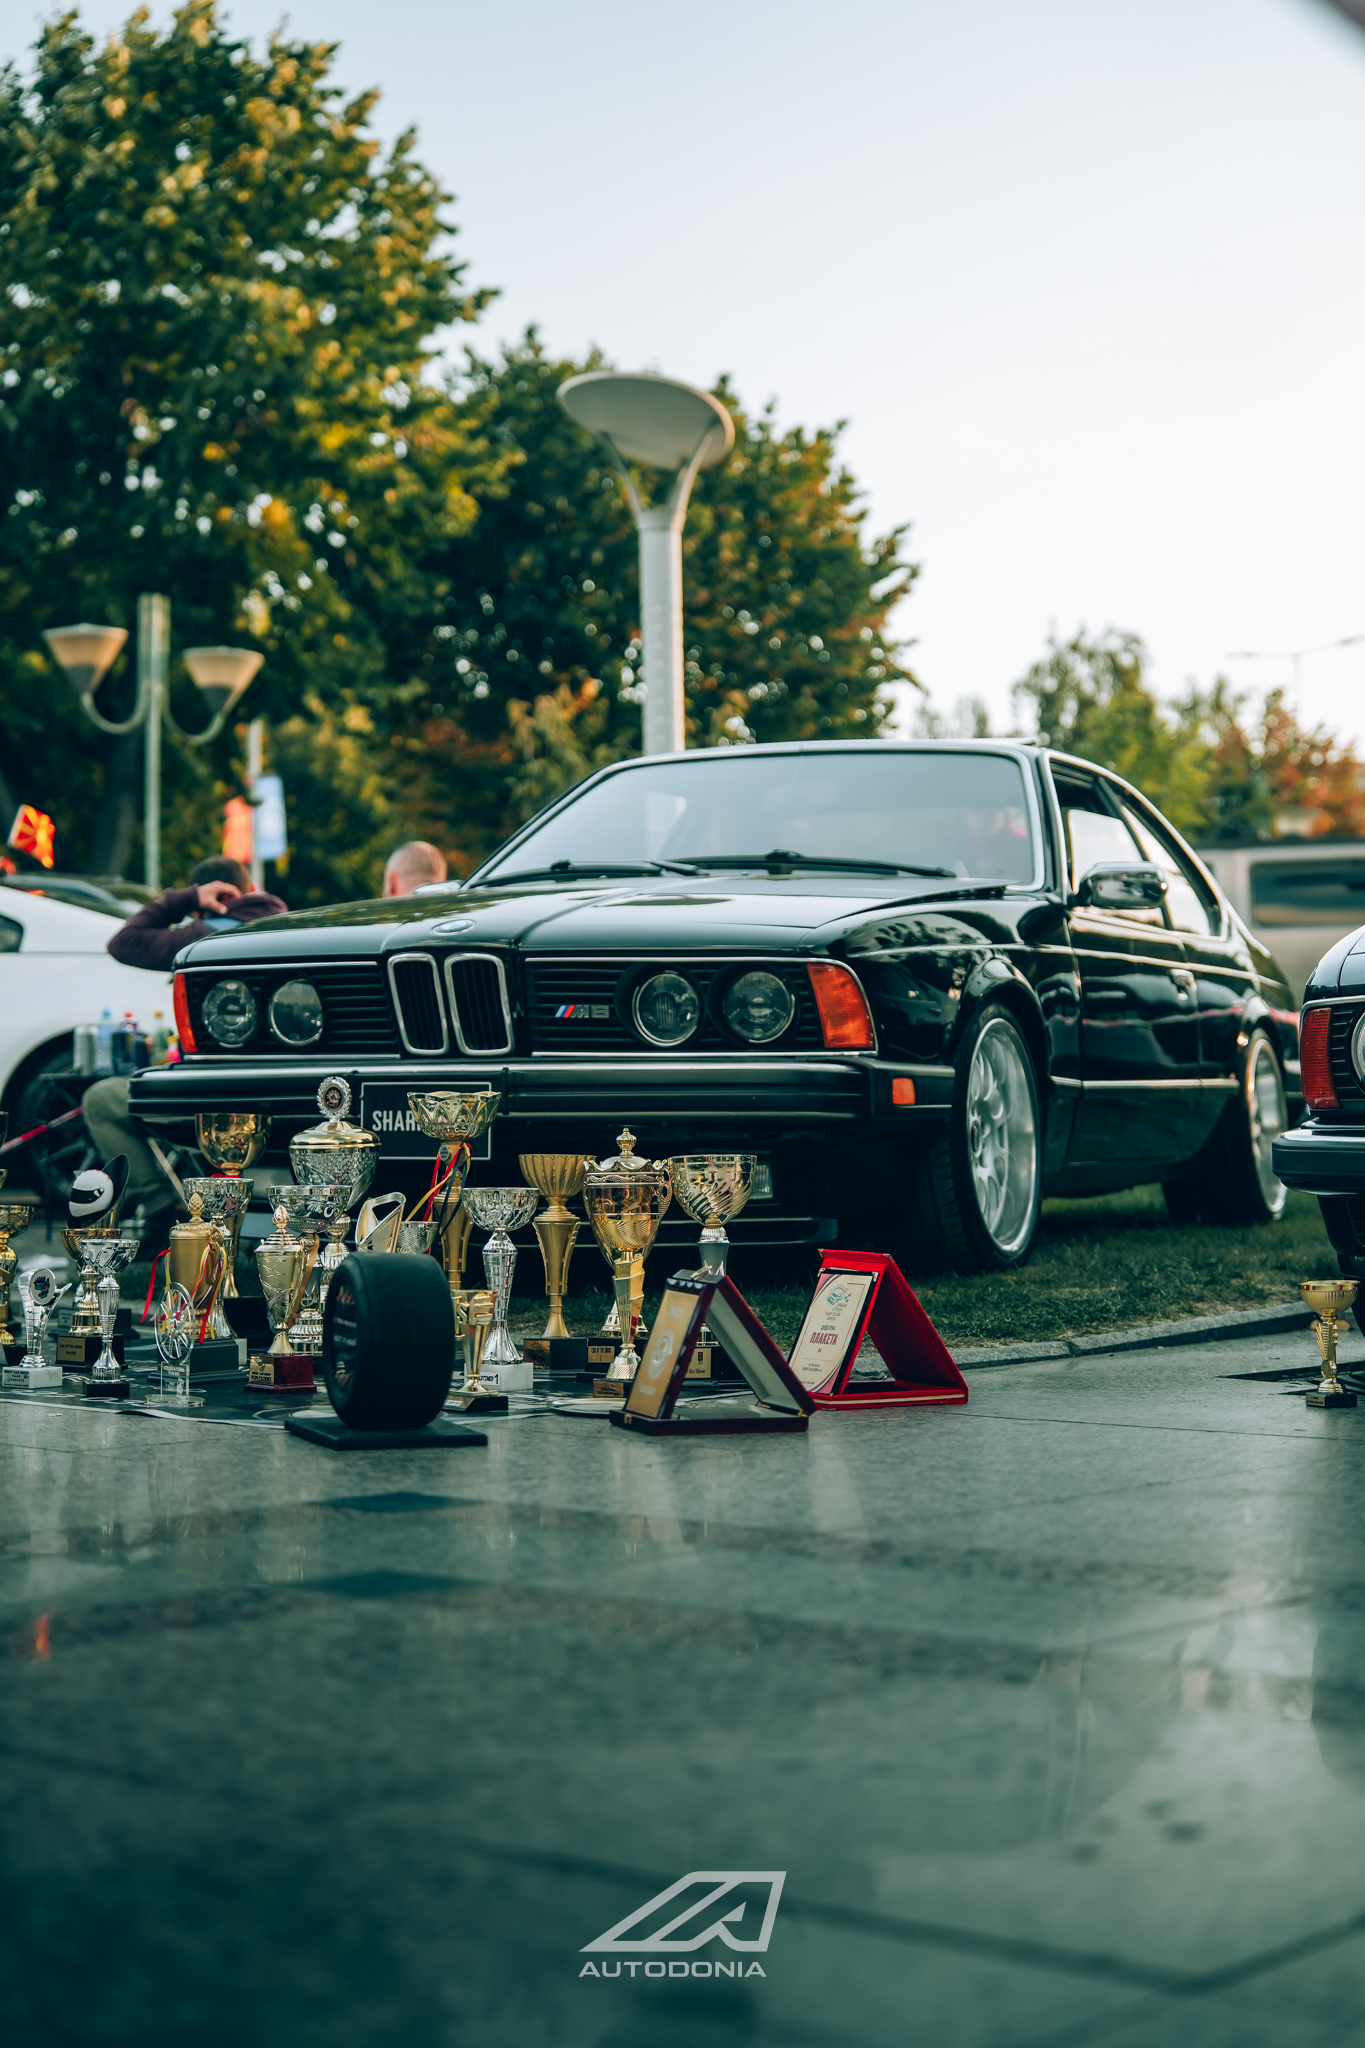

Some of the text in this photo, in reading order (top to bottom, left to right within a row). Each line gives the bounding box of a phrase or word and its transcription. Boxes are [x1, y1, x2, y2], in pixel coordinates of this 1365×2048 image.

[569, 1004, 610, 1018] M6
[372, 1110, 421, 1132] SHAR
[810, 1332, 838, 1345] ПЛАКЕТА
